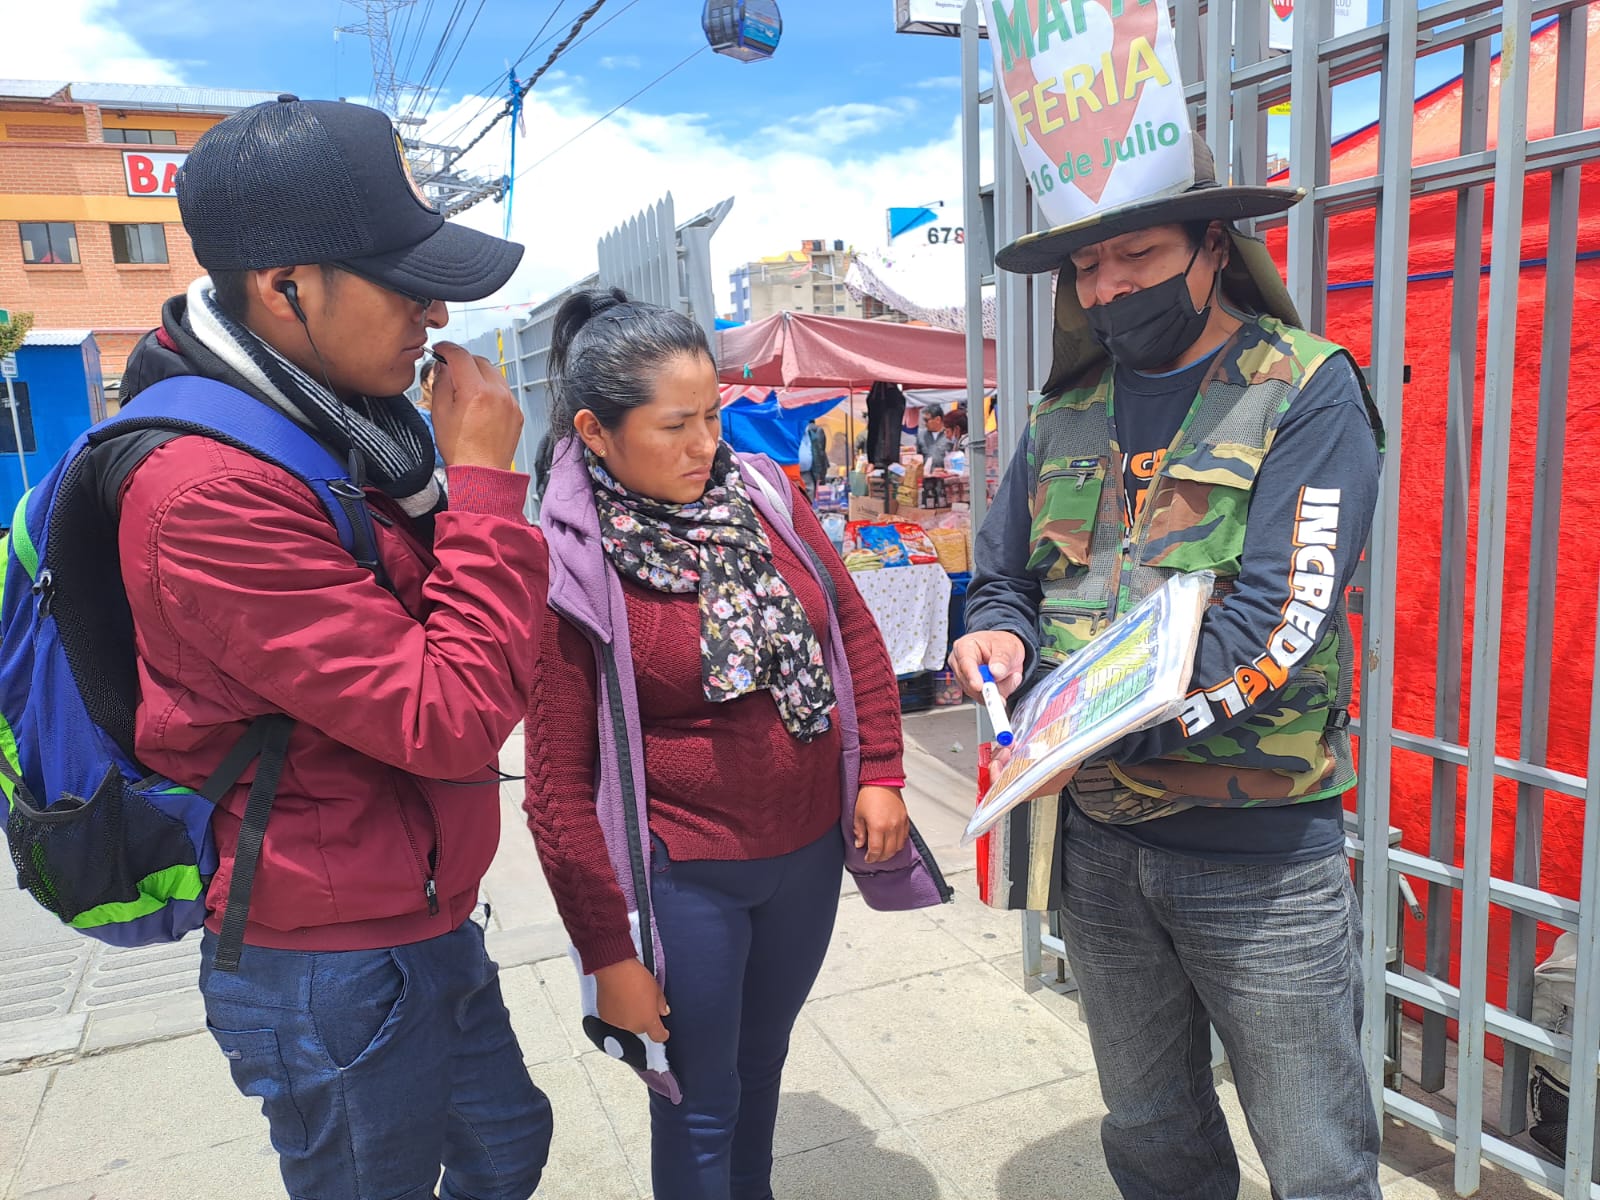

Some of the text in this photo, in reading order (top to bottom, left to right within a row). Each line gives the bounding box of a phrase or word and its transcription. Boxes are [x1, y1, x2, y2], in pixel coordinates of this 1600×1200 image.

[1011, 36, 1171, 146] FERIA
[1031, 121, 1180, 195] 16 de Julio
[927, 227, 965, 244] 678
